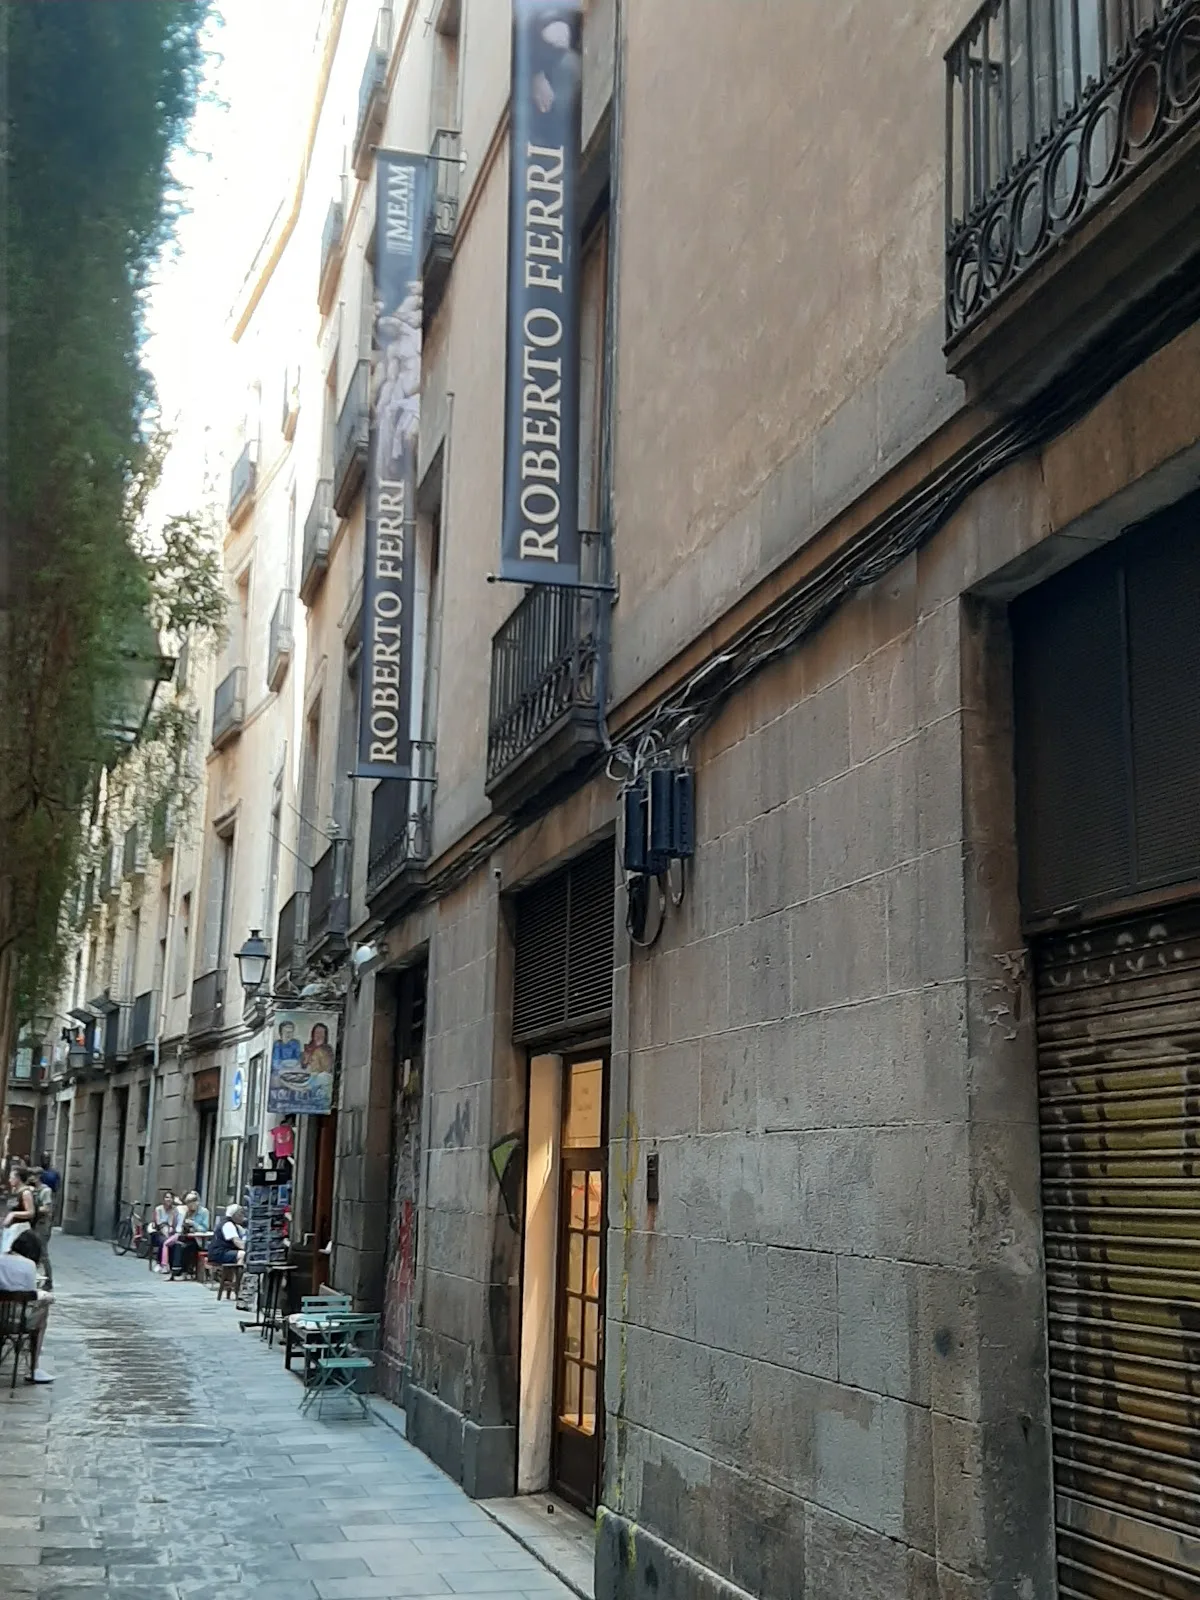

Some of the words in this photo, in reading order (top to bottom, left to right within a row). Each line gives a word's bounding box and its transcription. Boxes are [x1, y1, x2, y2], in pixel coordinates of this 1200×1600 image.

[386, 162, 410, 241] MEAM
[525, 141, 565, 293] FERRI
[520, 307, 564, 563] ROBERTO
[375, 477, 405, 581] FERRI
[369, 590, 403, 764] ROBERTO
